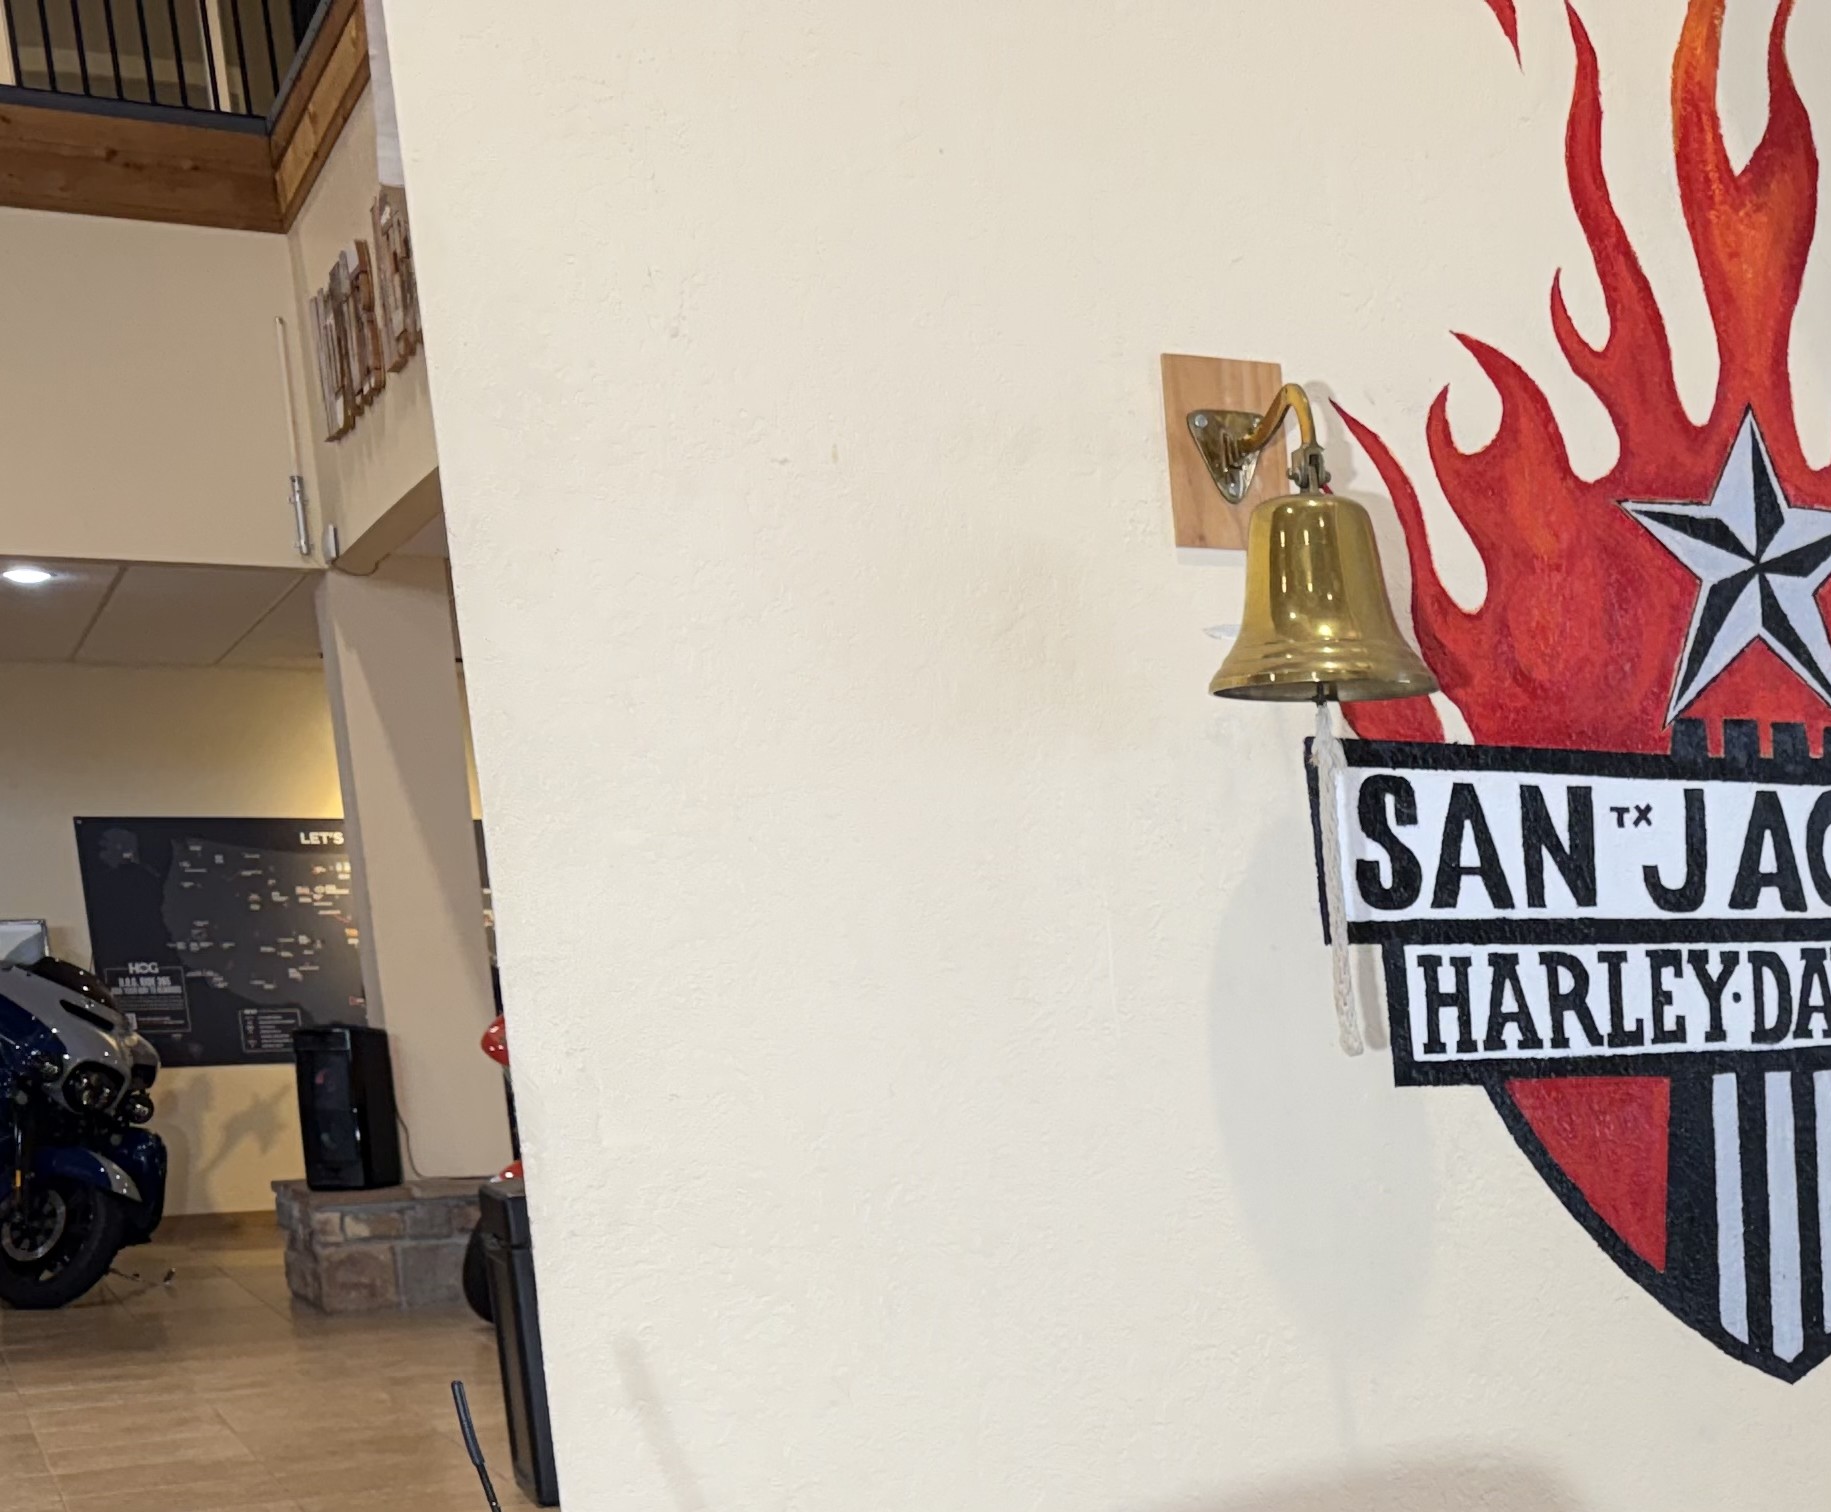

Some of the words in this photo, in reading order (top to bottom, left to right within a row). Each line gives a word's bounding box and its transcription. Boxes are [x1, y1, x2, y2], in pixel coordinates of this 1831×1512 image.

[300, 831, 344, 845] LET'S
[1357, 773, 1598, 911] SAN
[1610, 804, 1654, 829] TX
[128, 962, 159, 974] HOG
